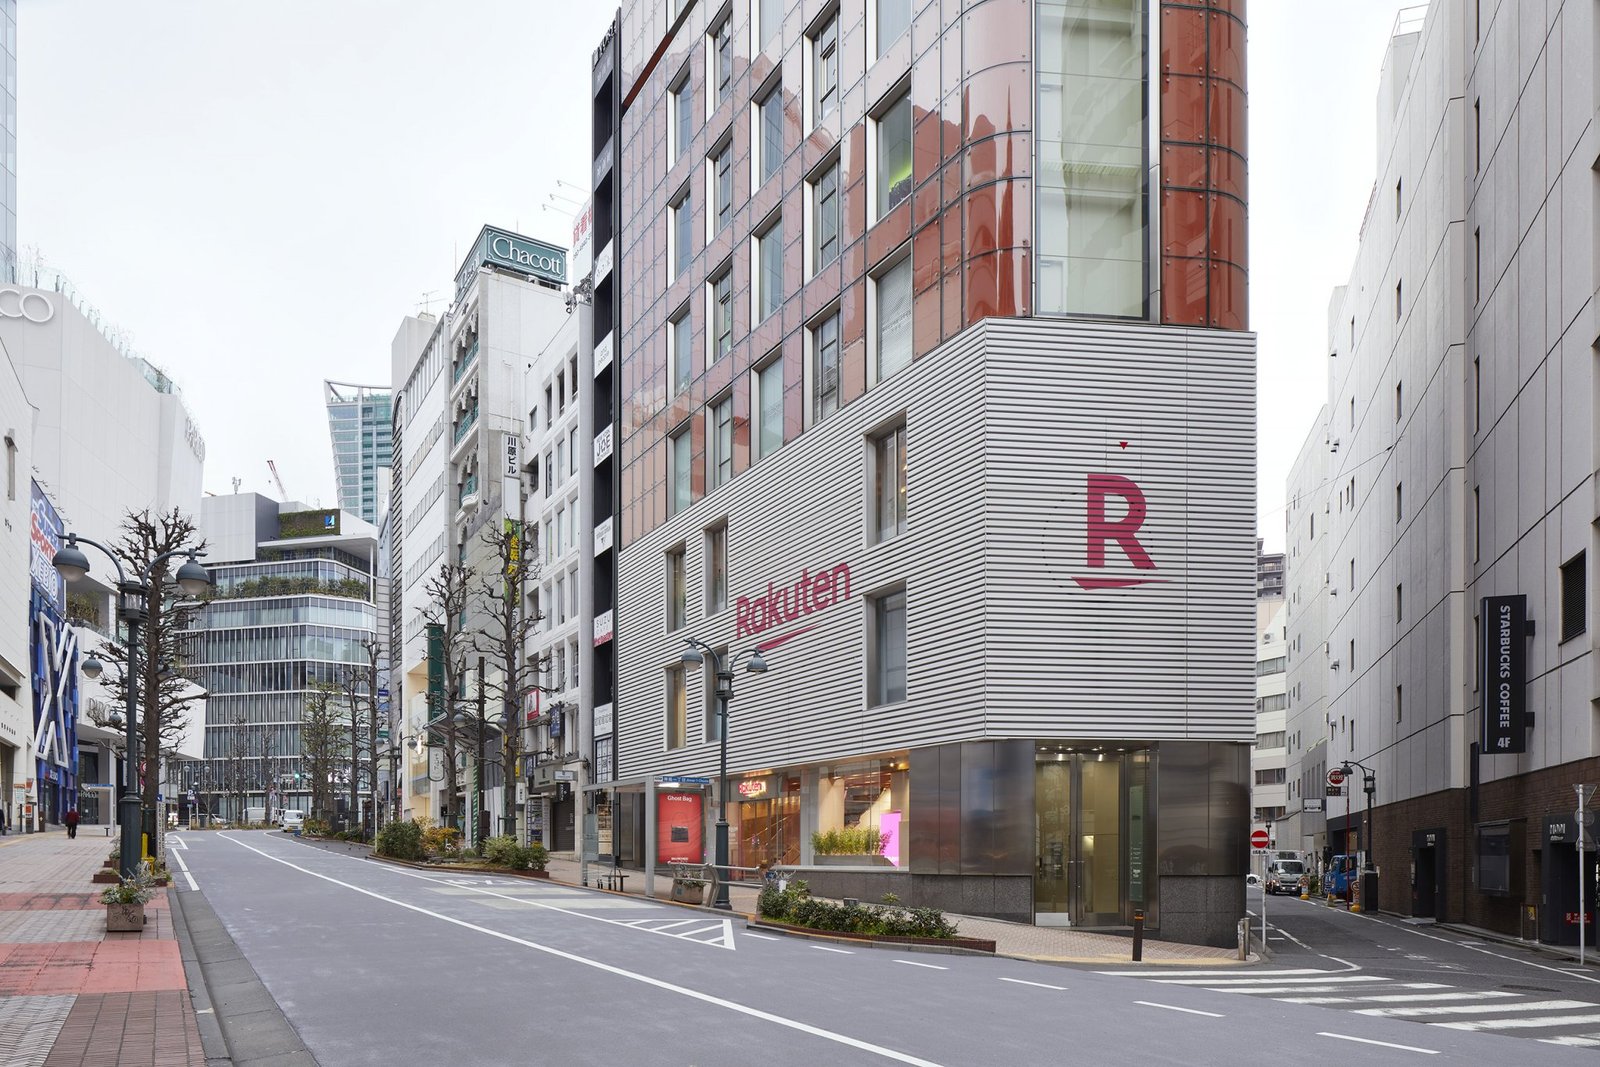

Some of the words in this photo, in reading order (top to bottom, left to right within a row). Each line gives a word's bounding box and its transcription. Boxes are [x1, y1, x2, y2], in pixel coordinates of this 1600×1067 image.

[493, 237, 561, 275] Chacott
[507, 436, 516, 474] 川原ビル
[1086, 473, 1158, 569] R
[737, 562, 850, 639] Rakuten
[1500, 605, 1511, 678] STARBUCKS
[1500, 682, 1510, 728] COFFEE
[1497, 737, 1510, 748] 4F
[682, 795, 692, 803] Bag
